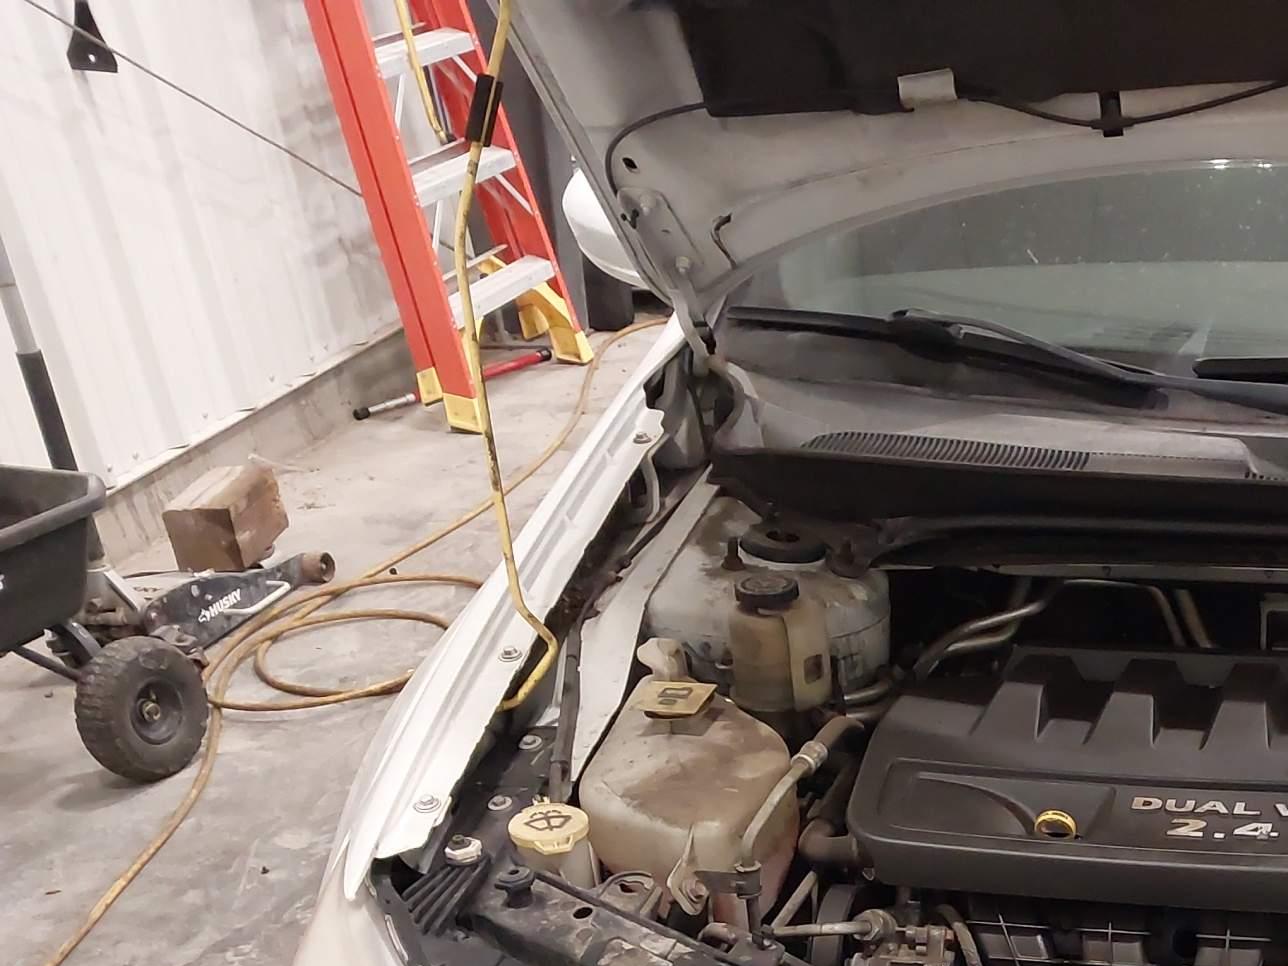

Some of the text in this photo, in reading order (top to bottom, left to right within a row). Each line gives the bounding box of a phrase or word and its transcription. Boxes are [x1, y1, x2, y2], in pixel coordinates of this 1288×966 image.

[208, 588, 241, 617] HUSKY
[1131, 796, 1261, 816] DUAL
[1166, 818, 1279, 840] 2.4
